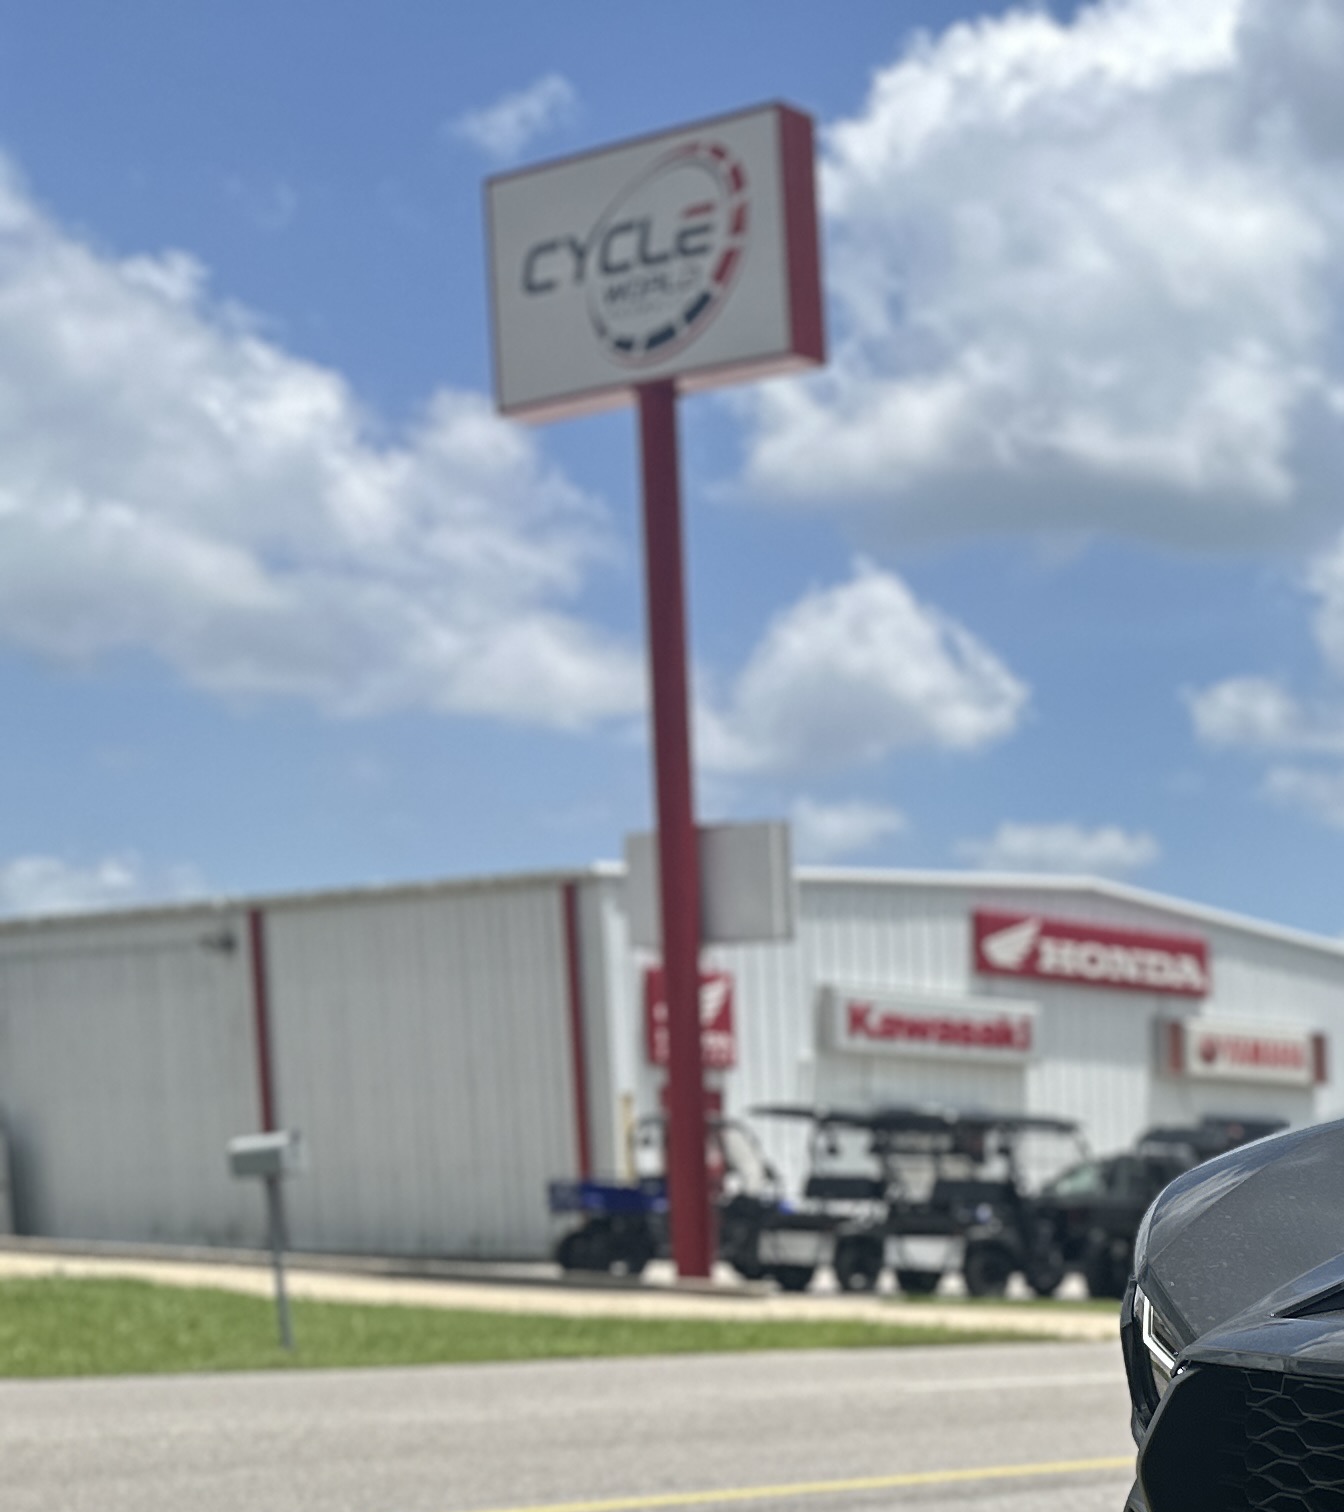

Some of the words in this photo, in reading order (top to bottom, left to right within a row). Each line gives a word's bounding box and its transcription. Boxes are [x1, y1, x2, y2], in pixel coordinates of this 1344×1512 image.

[521, 201, 715, 296] CYCLE
[1037, 934, 1208, 992] HONDA
[847, 1002, 1033, 1052] Kawasaki
